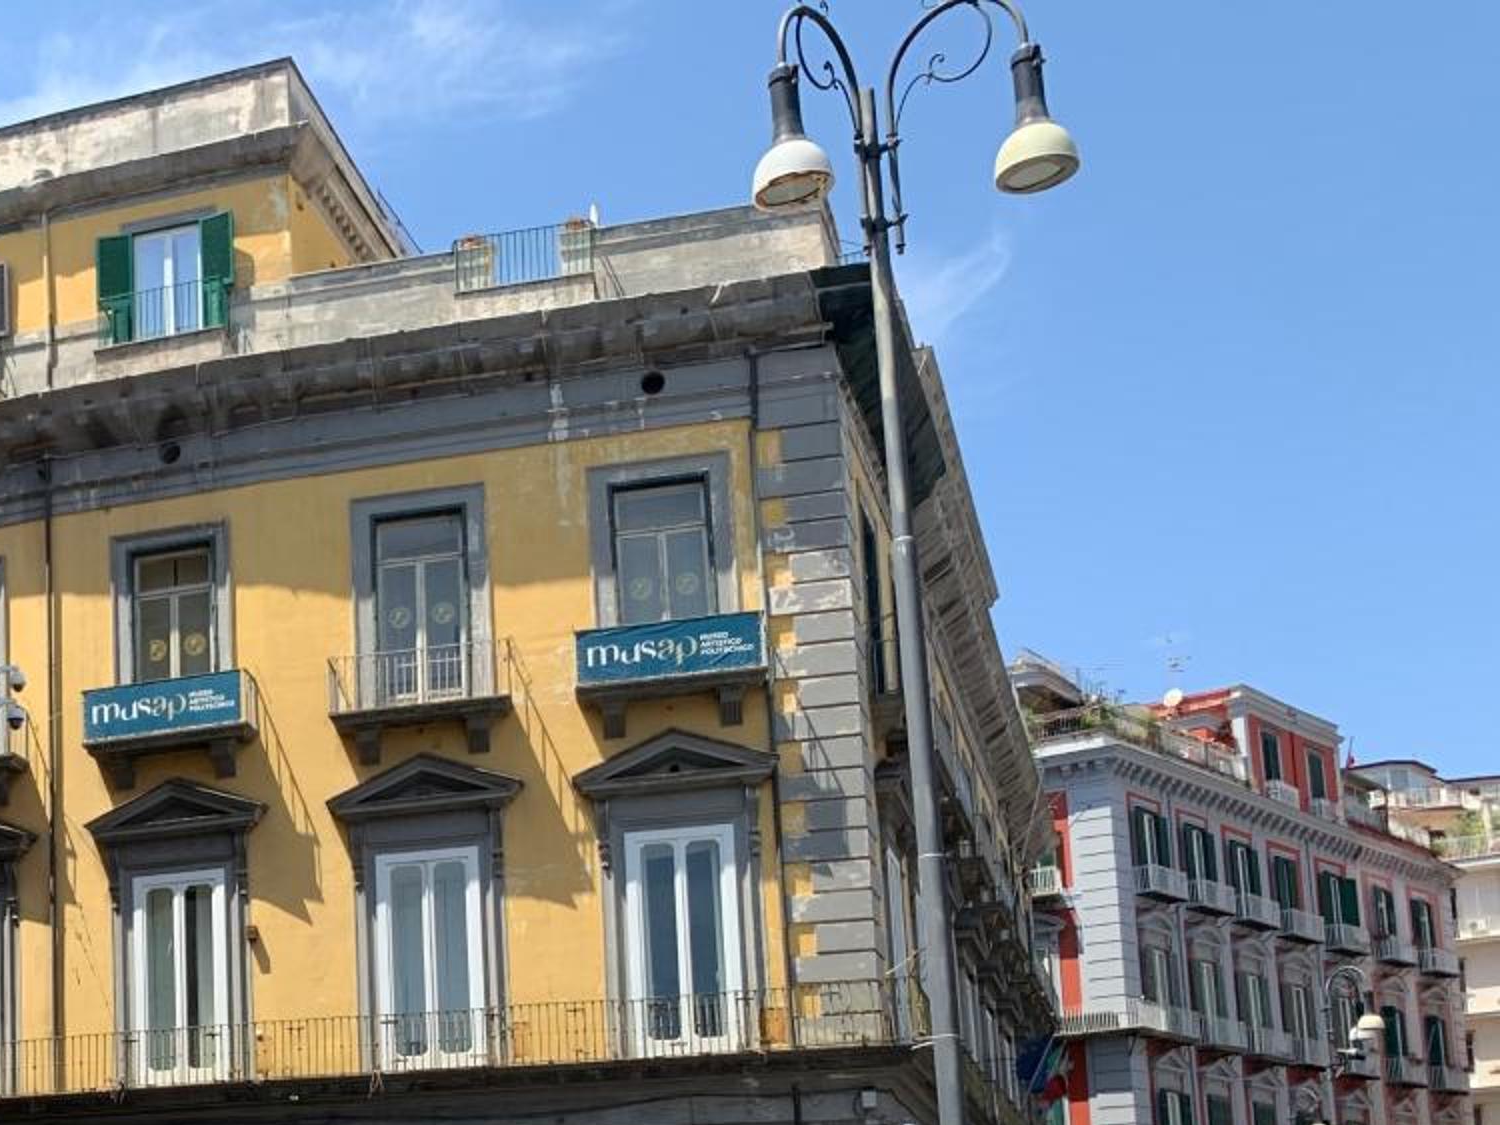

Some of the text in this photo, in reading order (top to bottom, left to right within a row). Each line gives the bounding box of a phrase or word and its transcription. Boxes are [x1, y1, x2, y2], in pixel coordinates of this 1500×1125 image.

[700, 631, 729, 641] MUSEO
[586, 635, 743, 668] musap ARTISTICO
[700, 644, 755, 655] POLITECNICO
[91, 693, 187, 725] musap
